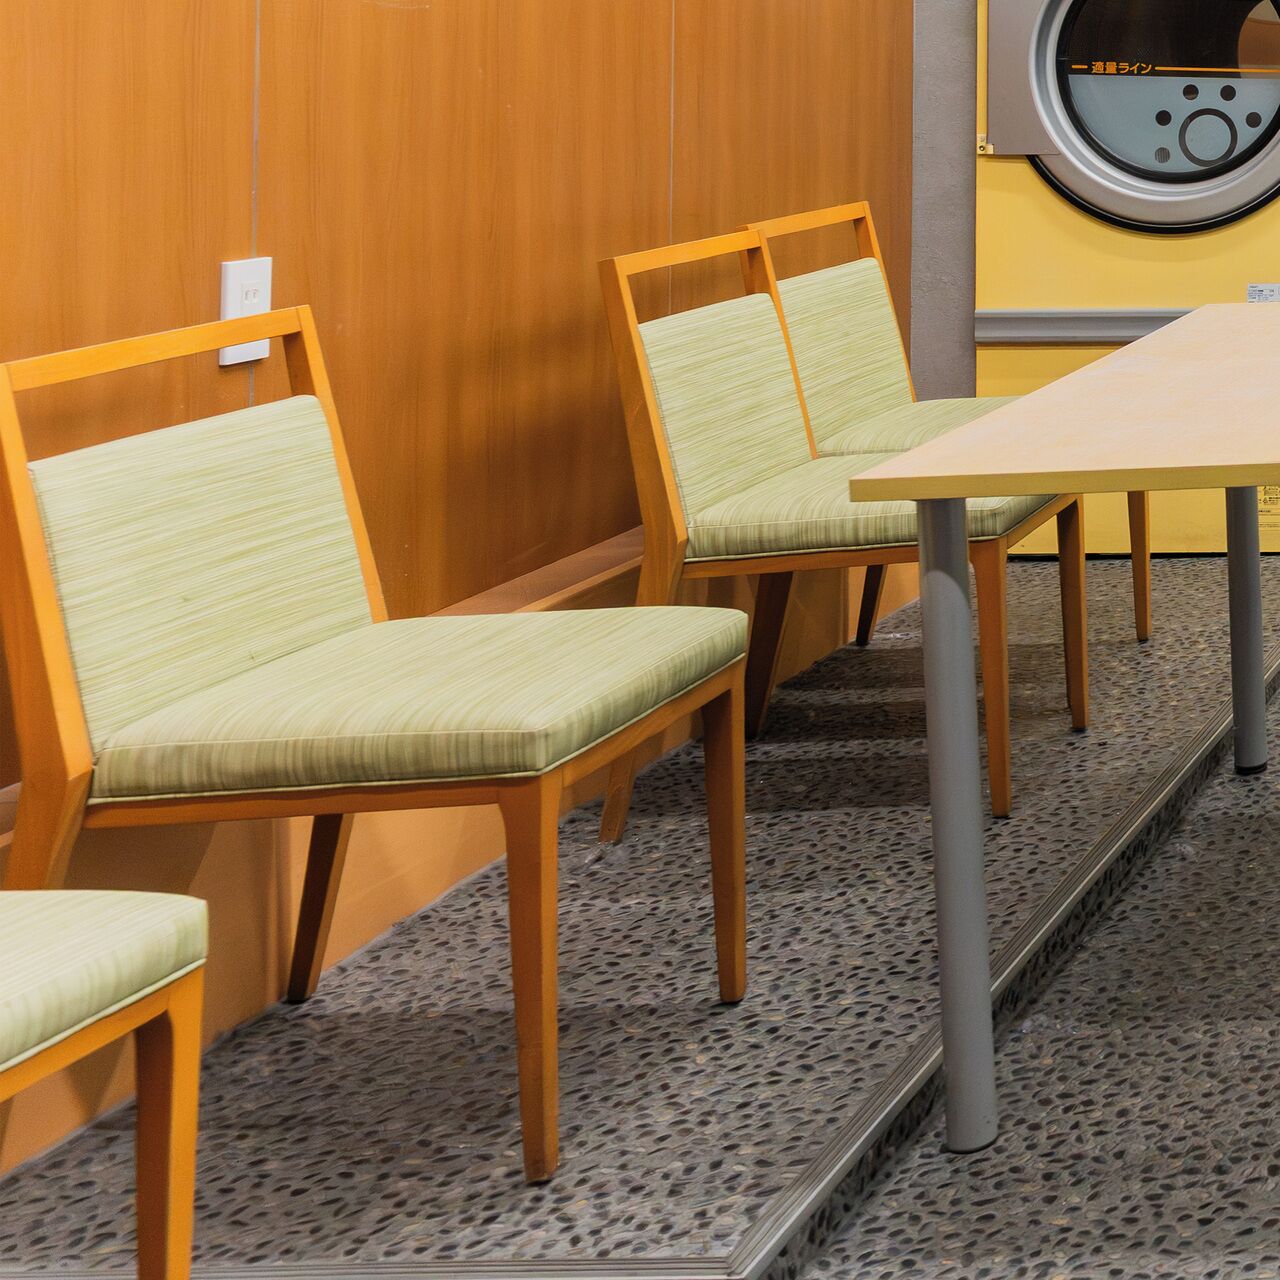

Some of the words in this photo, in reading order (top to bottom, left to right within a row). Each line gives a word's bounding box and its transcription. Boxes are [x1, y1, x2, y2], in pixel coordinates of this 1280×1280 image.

[1091, 61, 1152, 75] 適量ライン
